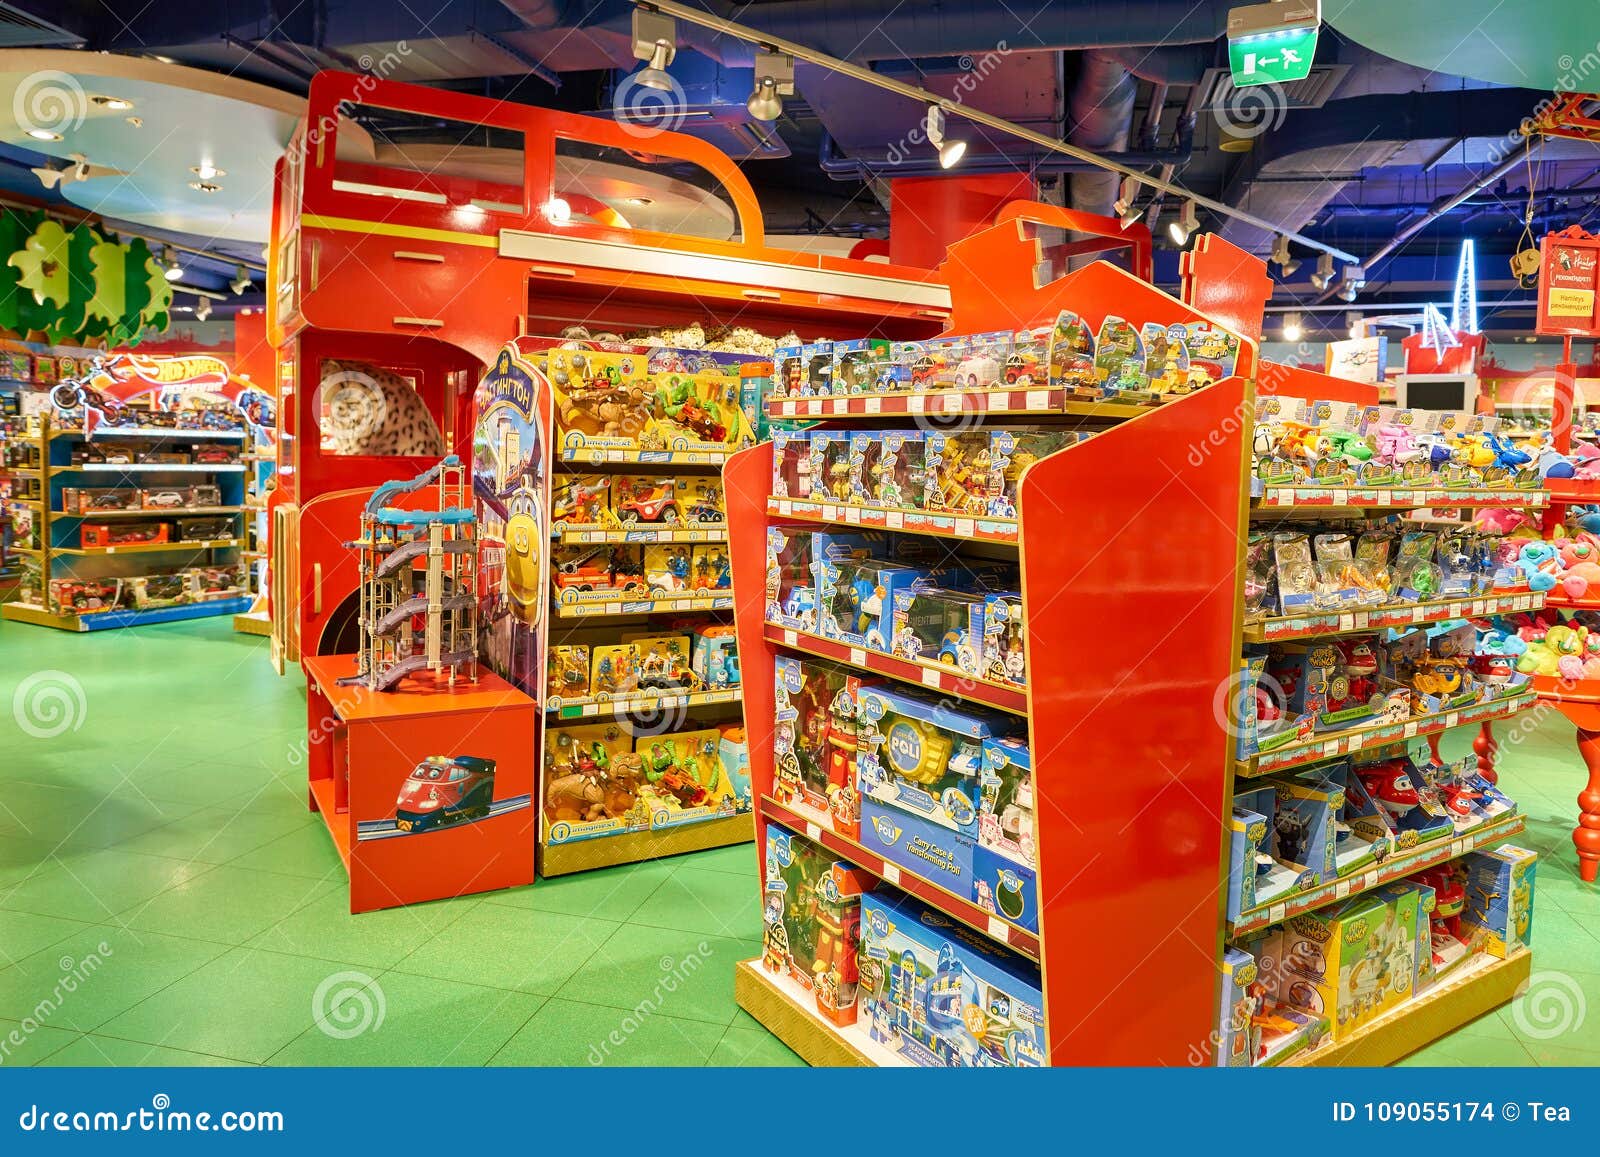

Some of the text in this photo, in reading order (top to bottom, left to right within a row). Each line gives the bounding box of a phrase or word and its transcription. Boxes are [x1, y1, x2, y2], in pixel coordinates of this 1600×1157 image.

[1167, 331, 1187, 339] POLI
[785, 673, 801, 686] POLI
[891, 736, 921, 760] POLI
[879, 824, 895, 839] POLI
[913, 835, 954, 861] Carry Case &
[906, 842, 961, 876] Transforming Poli
[871, 917, 888, 933] POLI
